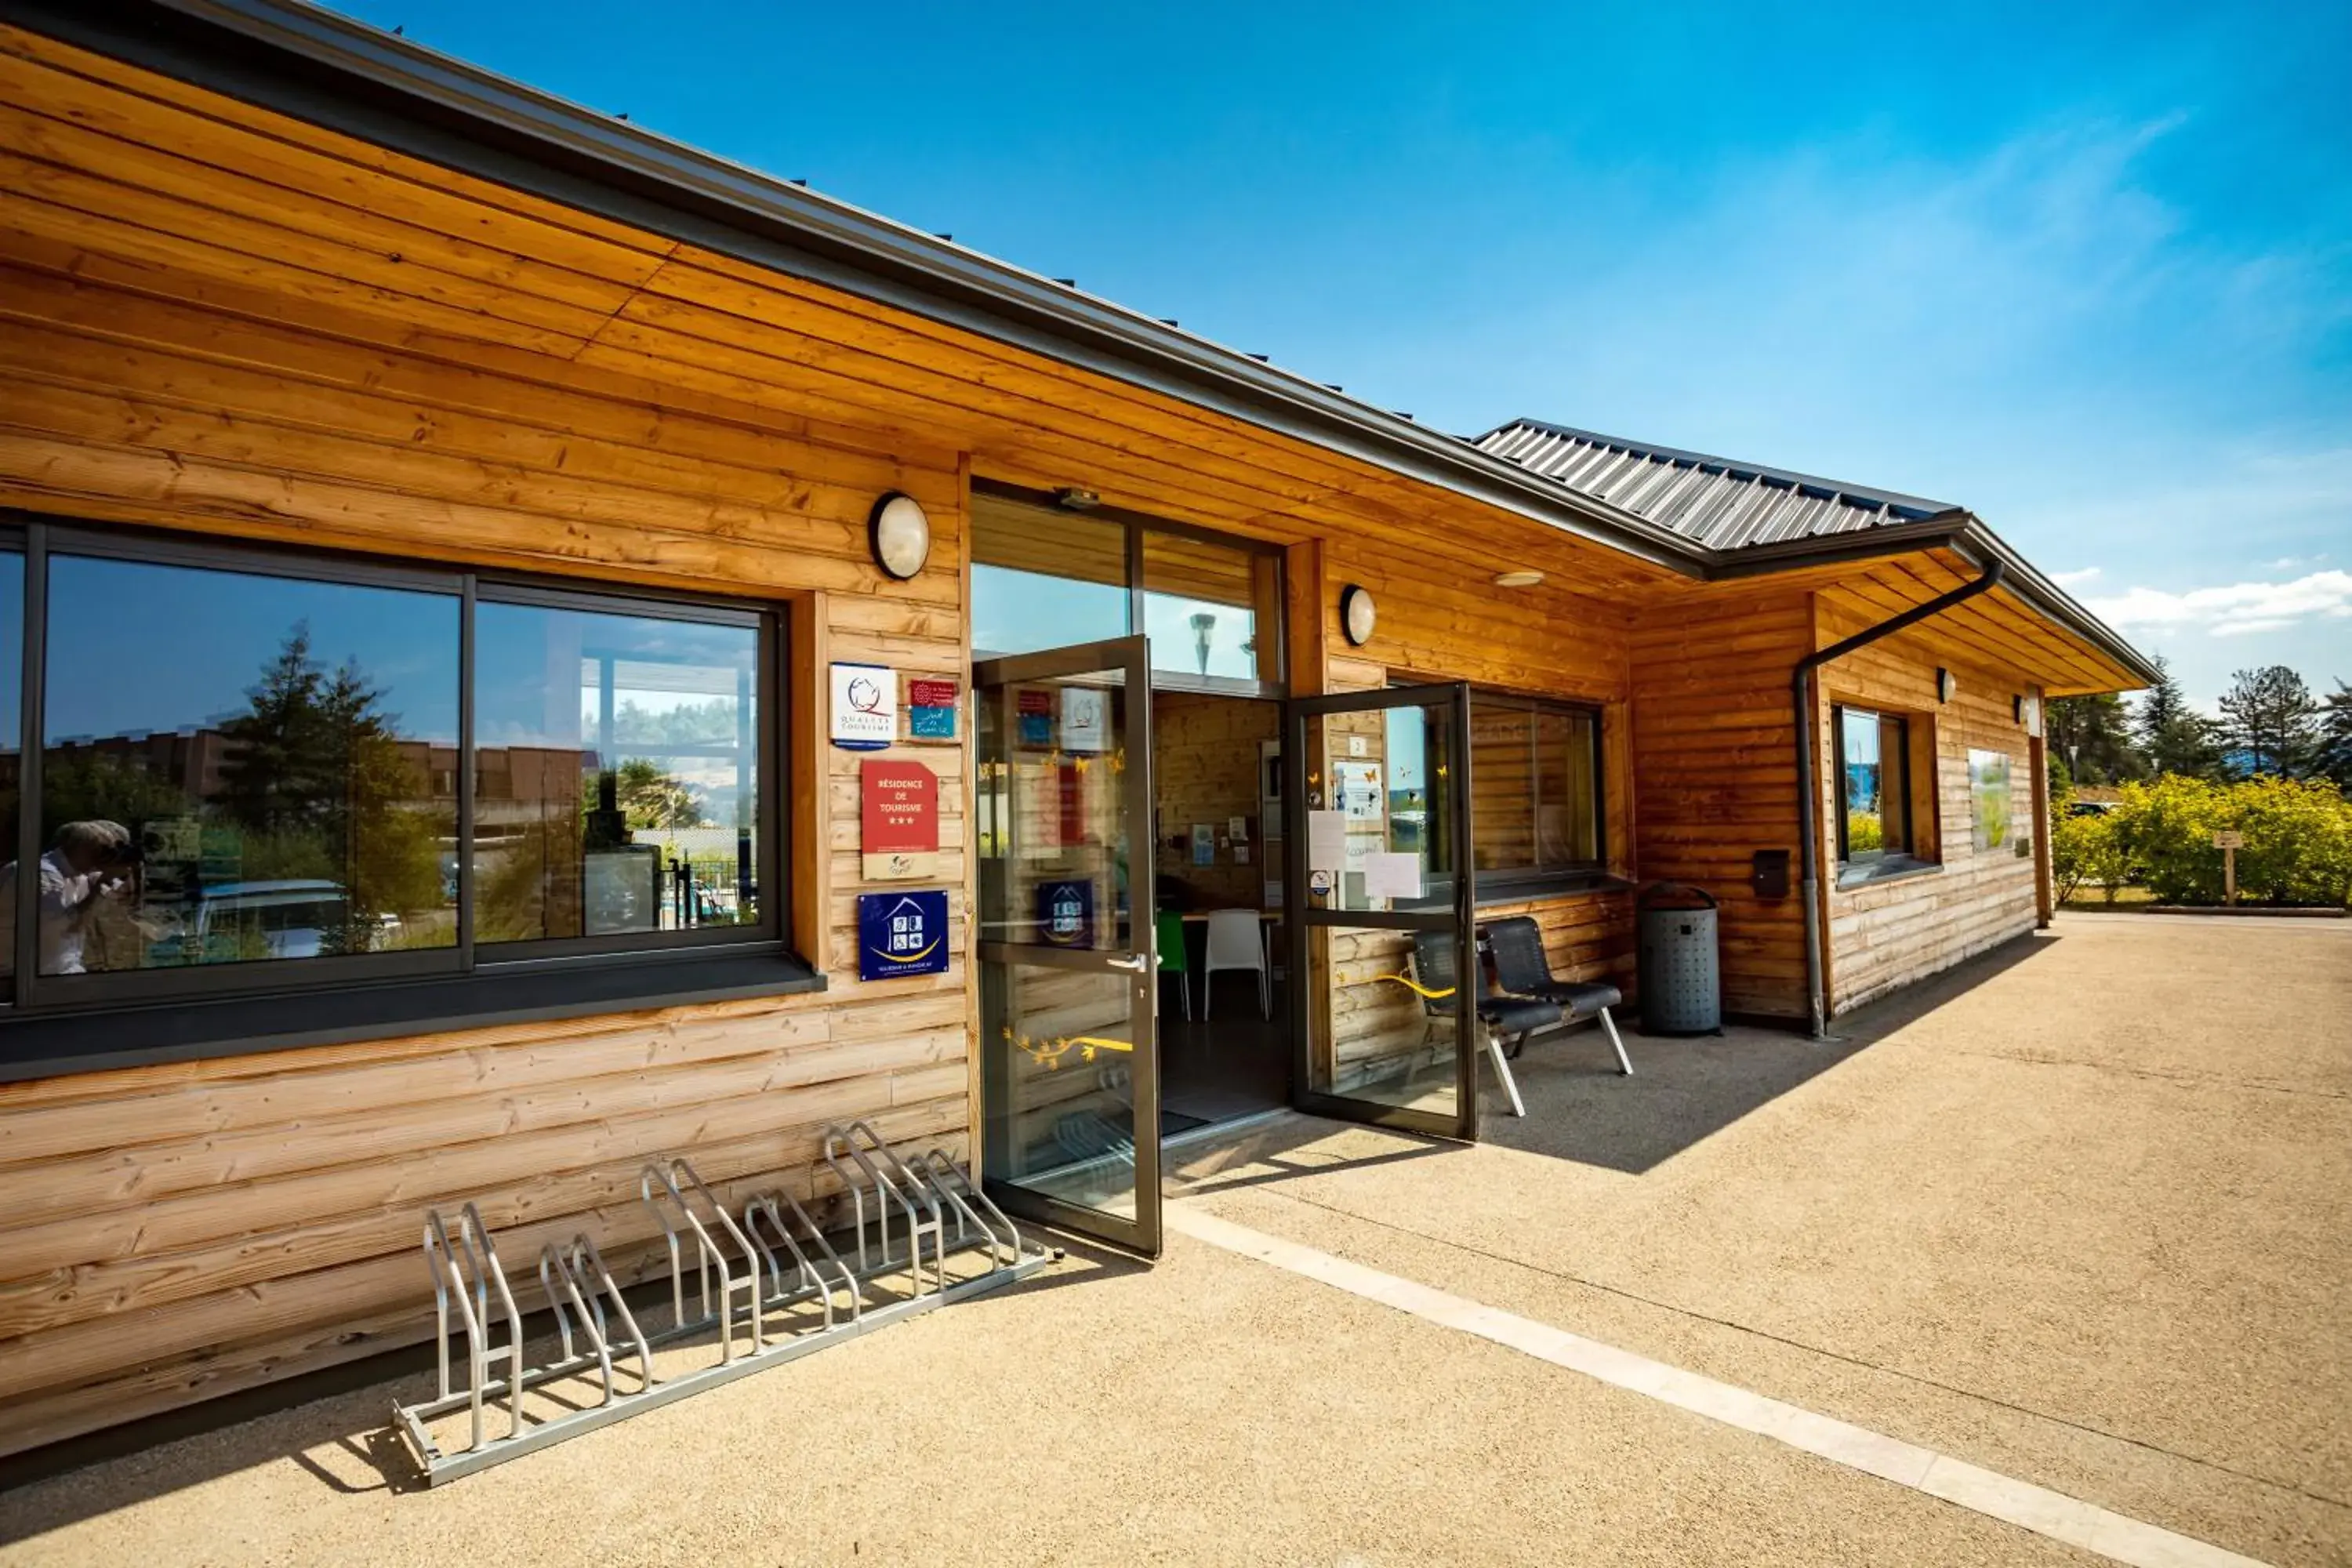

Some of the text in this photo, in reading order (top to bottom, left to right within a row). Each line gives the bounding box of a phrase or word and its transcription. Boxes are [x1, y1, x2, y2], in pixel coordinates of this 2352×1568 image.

[877, 779, 923, 789] RÉSIDENCE
[895, 792, 907, 800] DE
[879, 804, 922, 812] TOURISME
